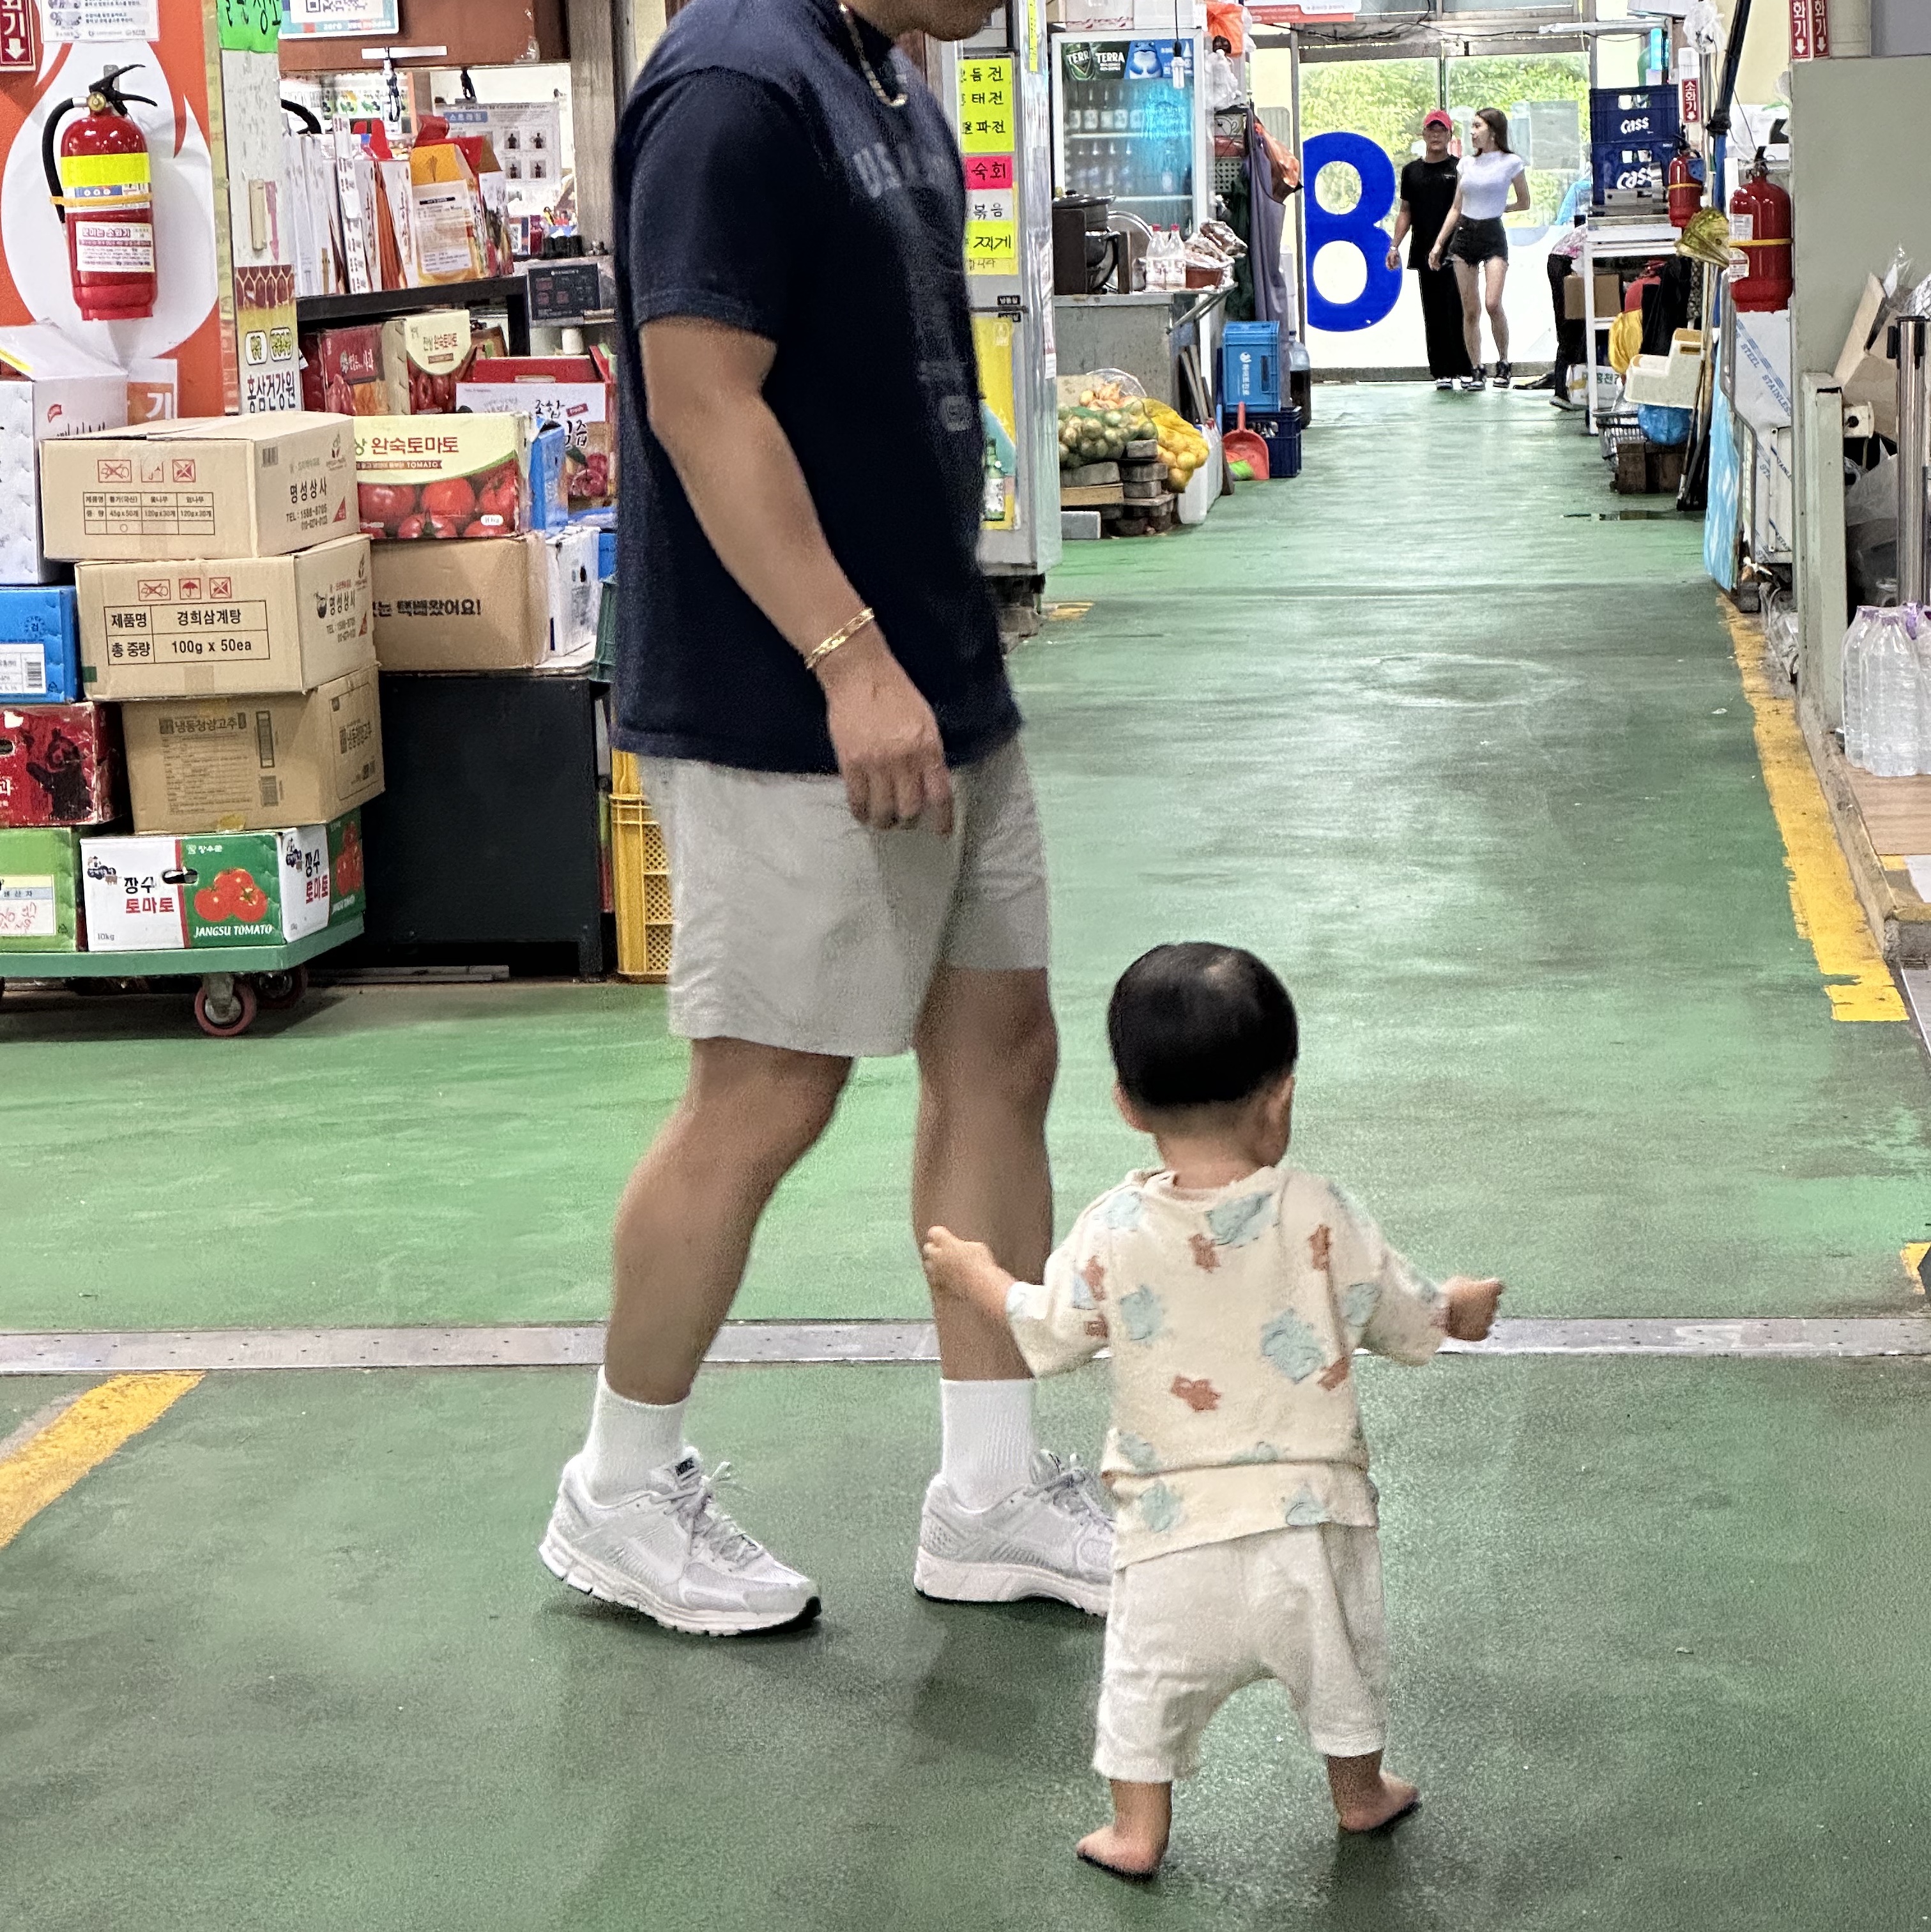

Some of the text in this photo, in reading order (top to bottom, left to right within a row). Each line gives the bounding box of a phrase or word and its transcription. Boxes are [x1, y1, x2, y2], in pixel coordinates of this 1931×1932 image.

[1095, 52, 1125, 63] TERRA
[1685, 81, 1697, 111] 소화기
[1621, 117, 1649, 134] Cass
[972, 162, 1006, 181] 숙회
[973, 202, 1003, 220] 볶음
[1741, 343, 1760, 369] STEEL
[247, 371, 296, 413] 홍삼건강원
[371, 437, 459, 455] 완숙토마토
[290, 476, 327, 503] 명성상사
[111, 612, 147, 628] 제품명
[177, 609, 241, 626] 경희삼계탕
[112, 641, 150, 658] 총 중량
[172, 639, 252, 654] 100g x 50ea
[124, 876, 155, 894] 장수
[126, 897, 175, 914] 토마토
[98, 933, 115, 941] 10kg
[194, 924, 273, 938] JANGSU TOMATO
